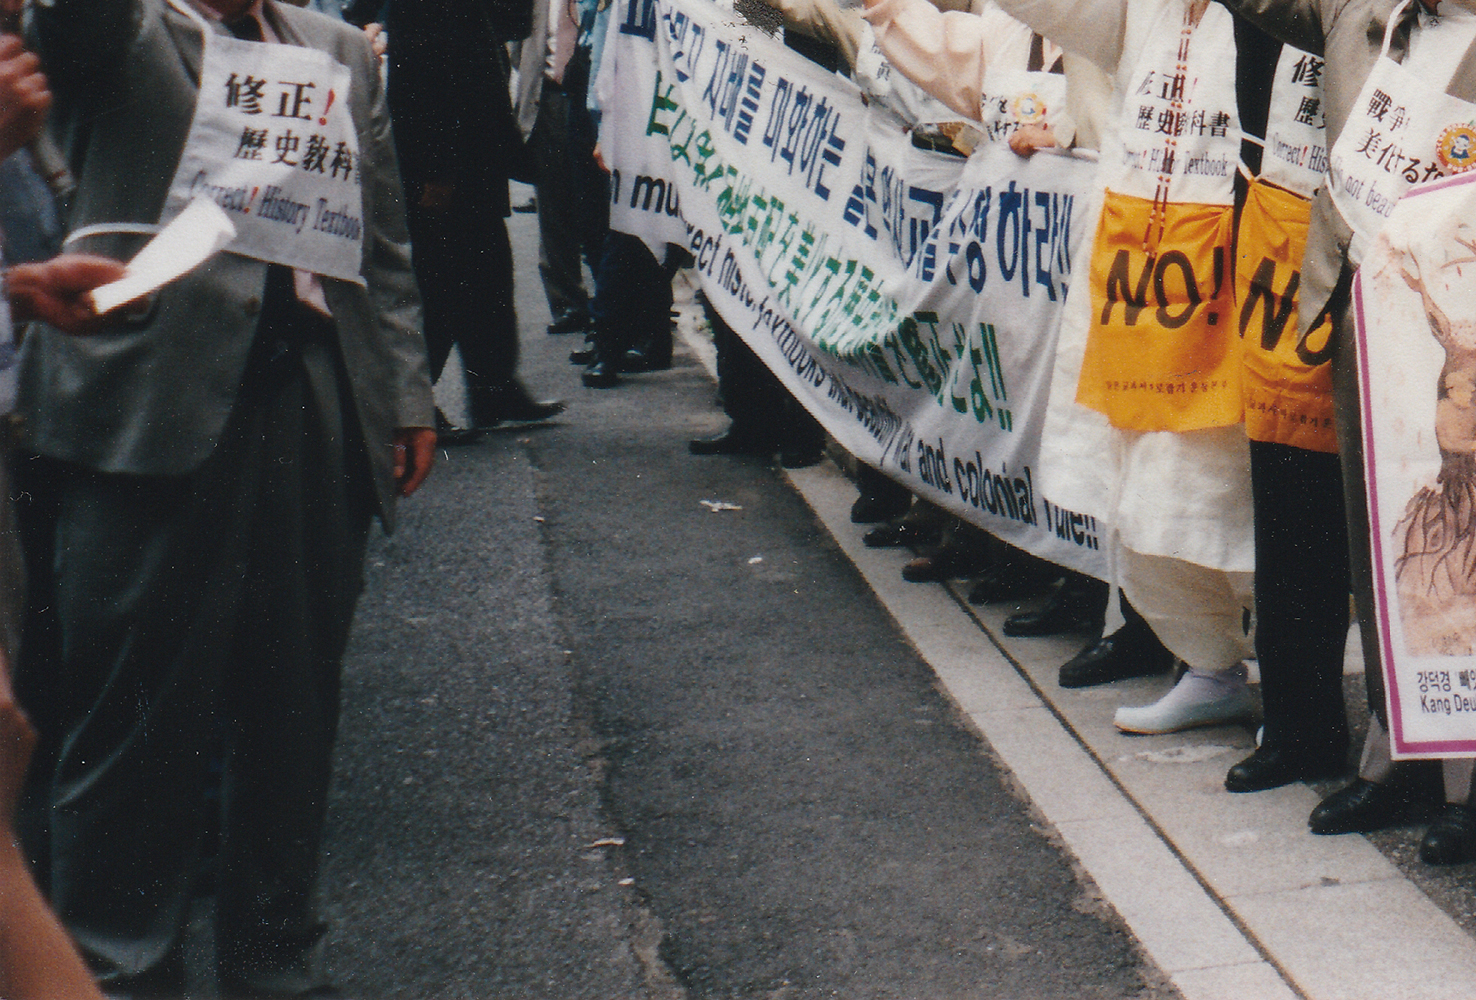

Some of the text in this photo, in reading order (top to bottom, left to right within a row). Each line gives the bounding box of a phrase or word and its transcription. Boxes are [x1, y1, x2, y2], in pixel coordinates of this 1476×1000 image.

[224, 72, 336, 126] 修正!
[763, 76, 846, 201] 미화하는
[1100, 246, 1225, 330] NO!
[917, 437, 953, 494] and
[953, 450, 1038, 527] colonial
[1419, 693, 1453, 716] Kang
